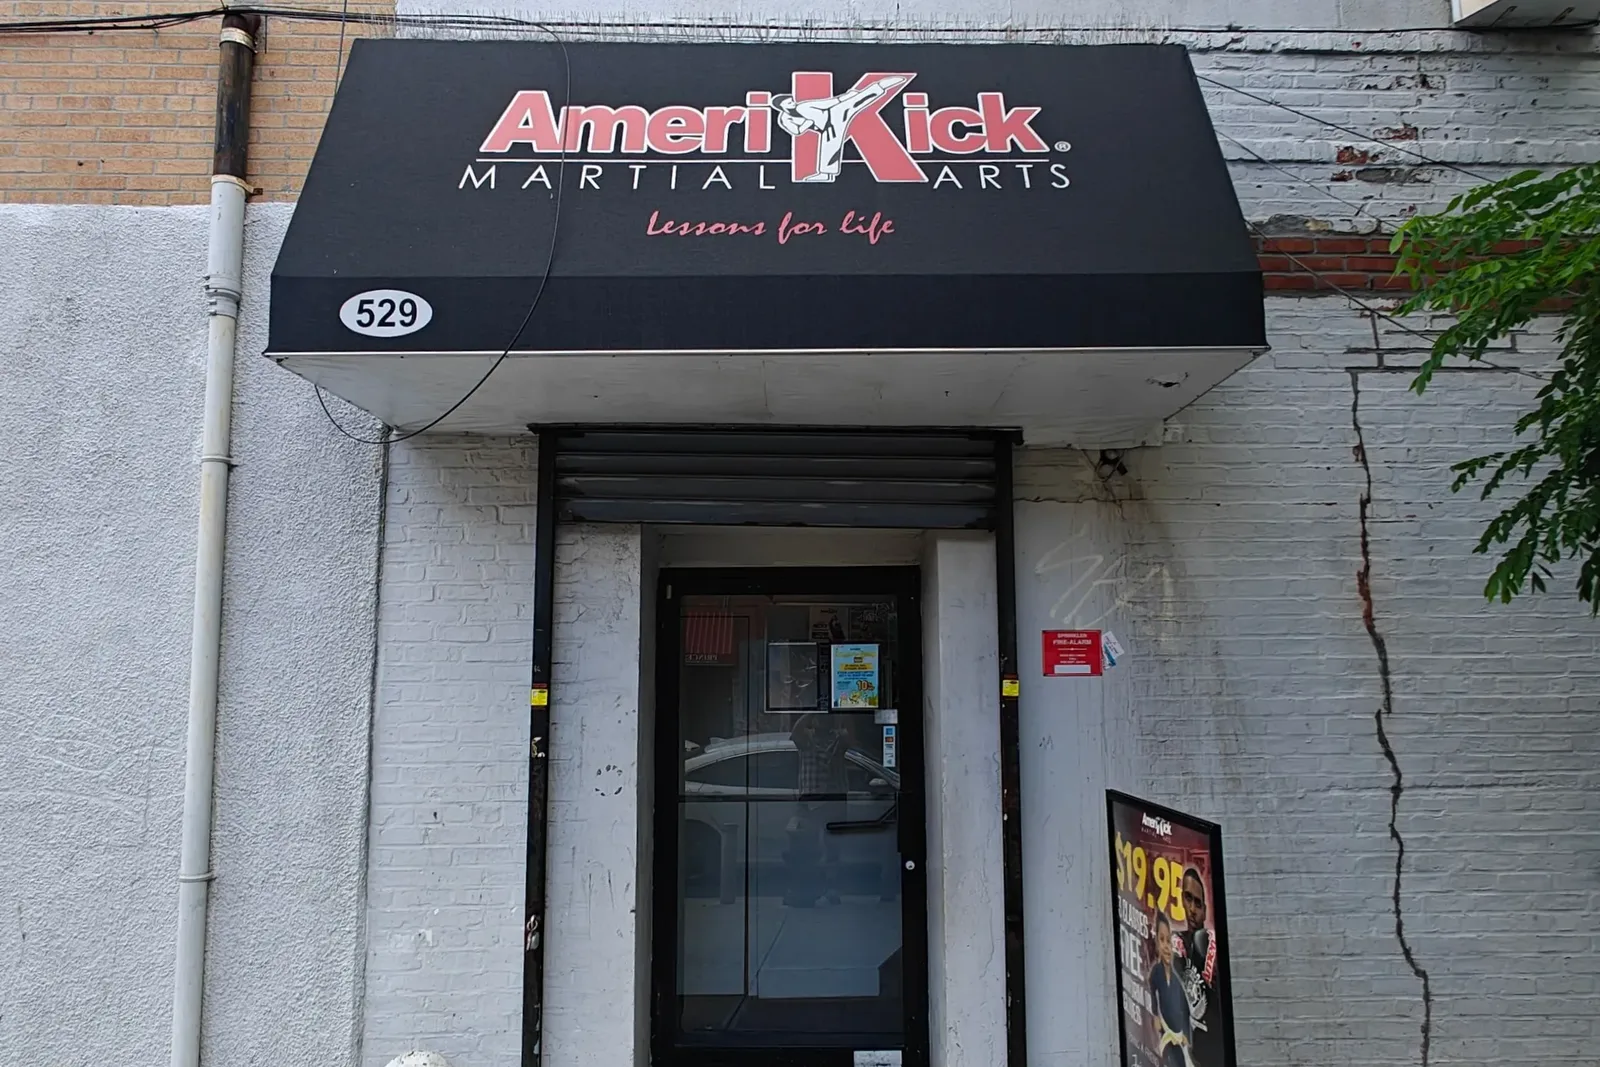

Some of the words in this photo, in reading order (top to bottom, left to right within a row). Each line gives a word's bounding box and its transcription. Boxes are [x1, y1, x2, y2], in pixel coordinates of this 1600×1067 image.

[479, 71, 1050, 183] AmeriKick
[458, 164, 776, 191] MARTIAL
[932, 163, 1071, 190] ARTS
[646, 211, 766, 236] Lessons
[777, 211, 828, 245] for
[840, 210, 895, 245] life
[356, 298, 417, 328] 529
[1115, 832, 1187, 921] $19.95
[1120, 924, 1144, 981] FREE
